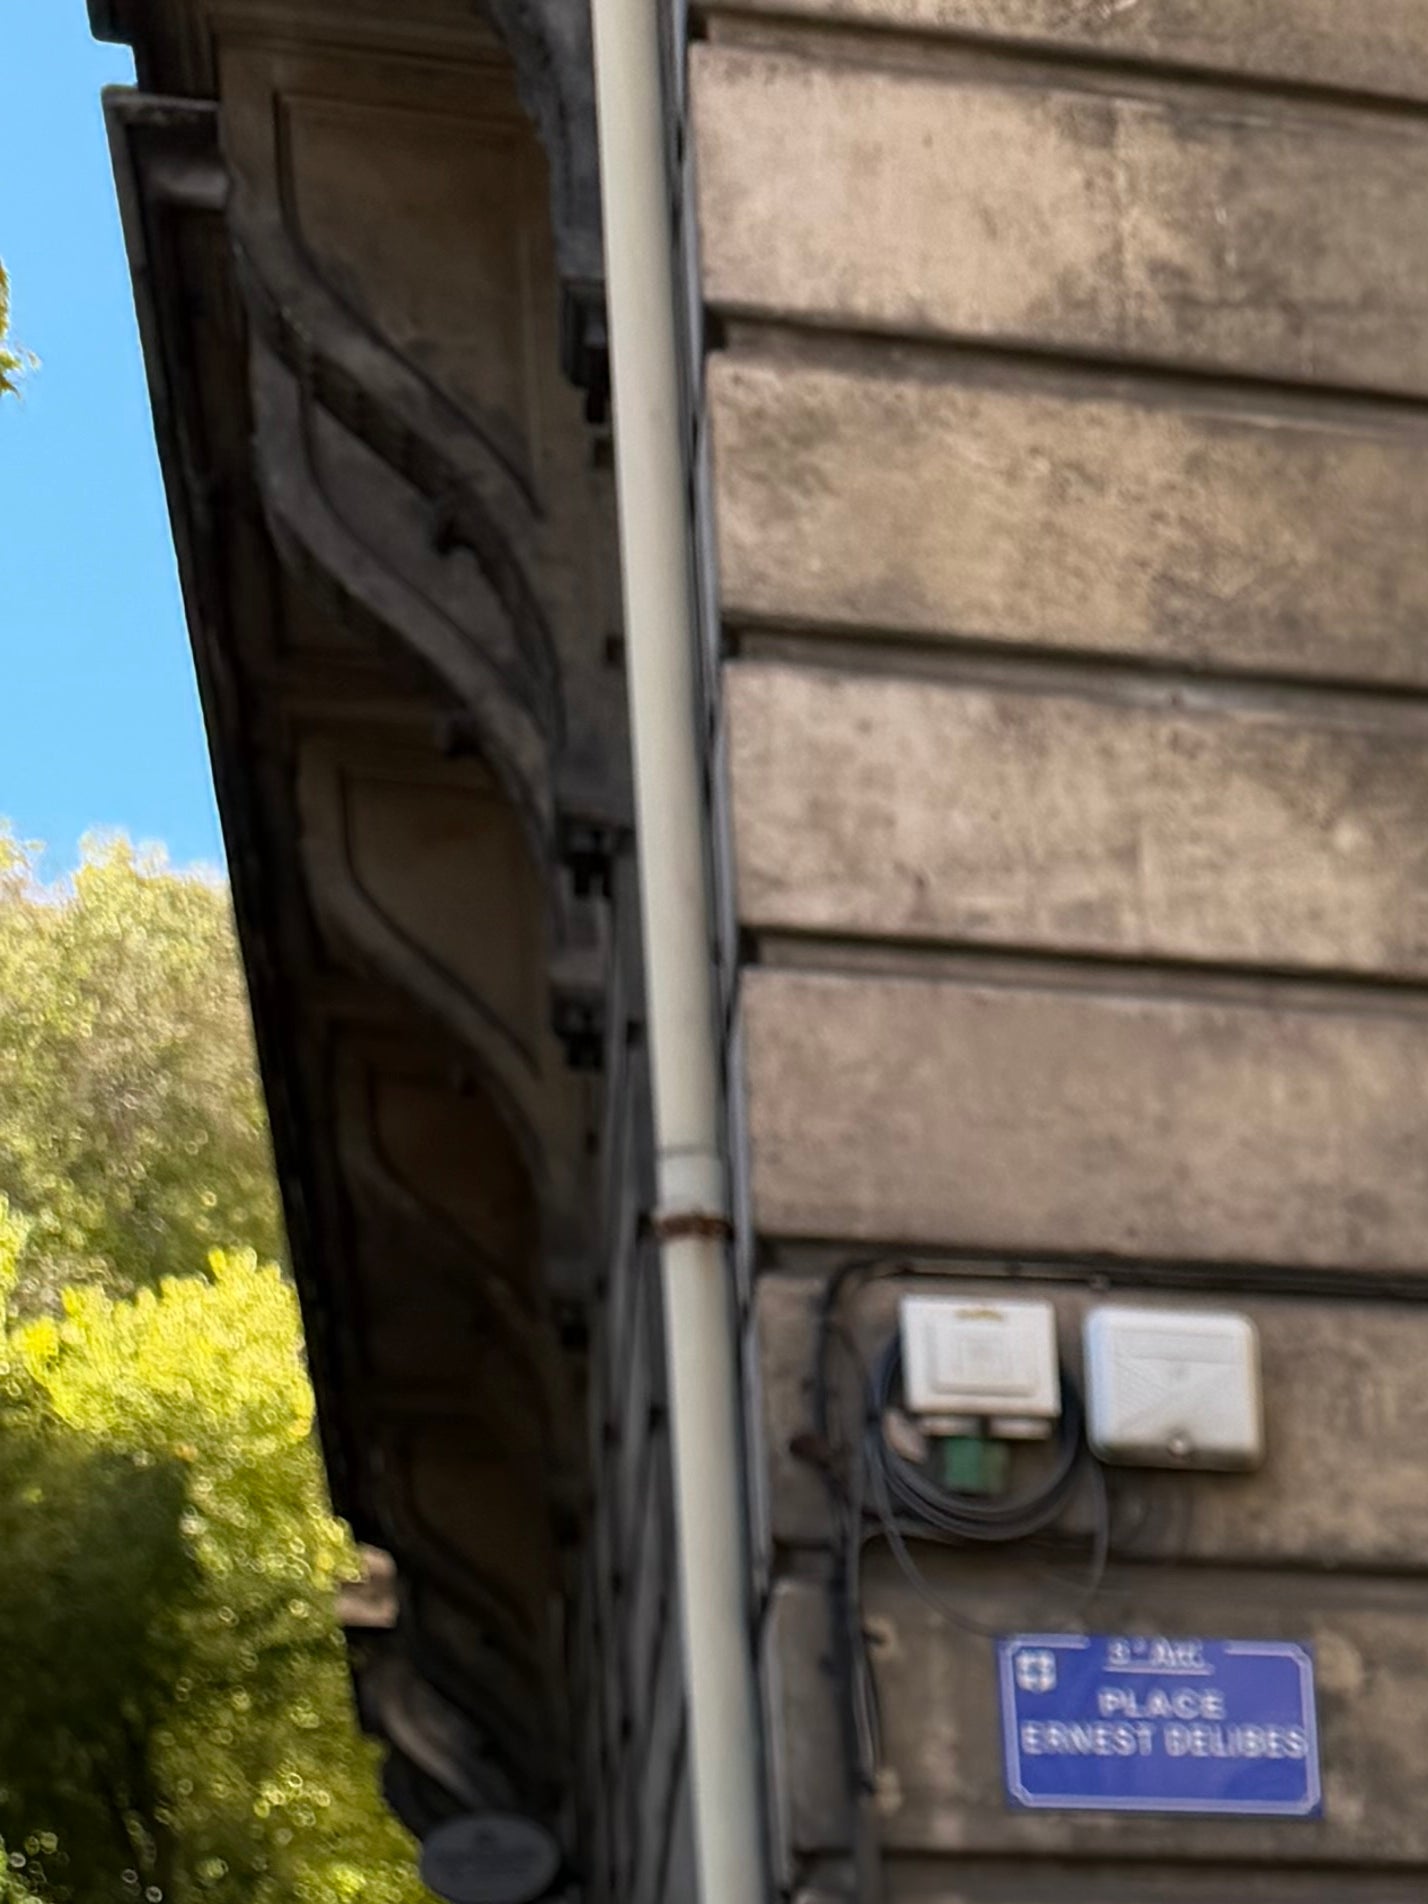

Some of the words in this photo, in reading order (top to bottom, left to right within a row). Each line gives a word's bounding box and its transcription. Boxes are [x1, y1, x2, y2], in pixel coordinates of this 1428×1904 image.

[1099, 1687, 1226, 1720] PLACE
[1021, 1720, 1153, 1756] ERNEST
[1164, 1723, 1307, 1758] DELIBES
